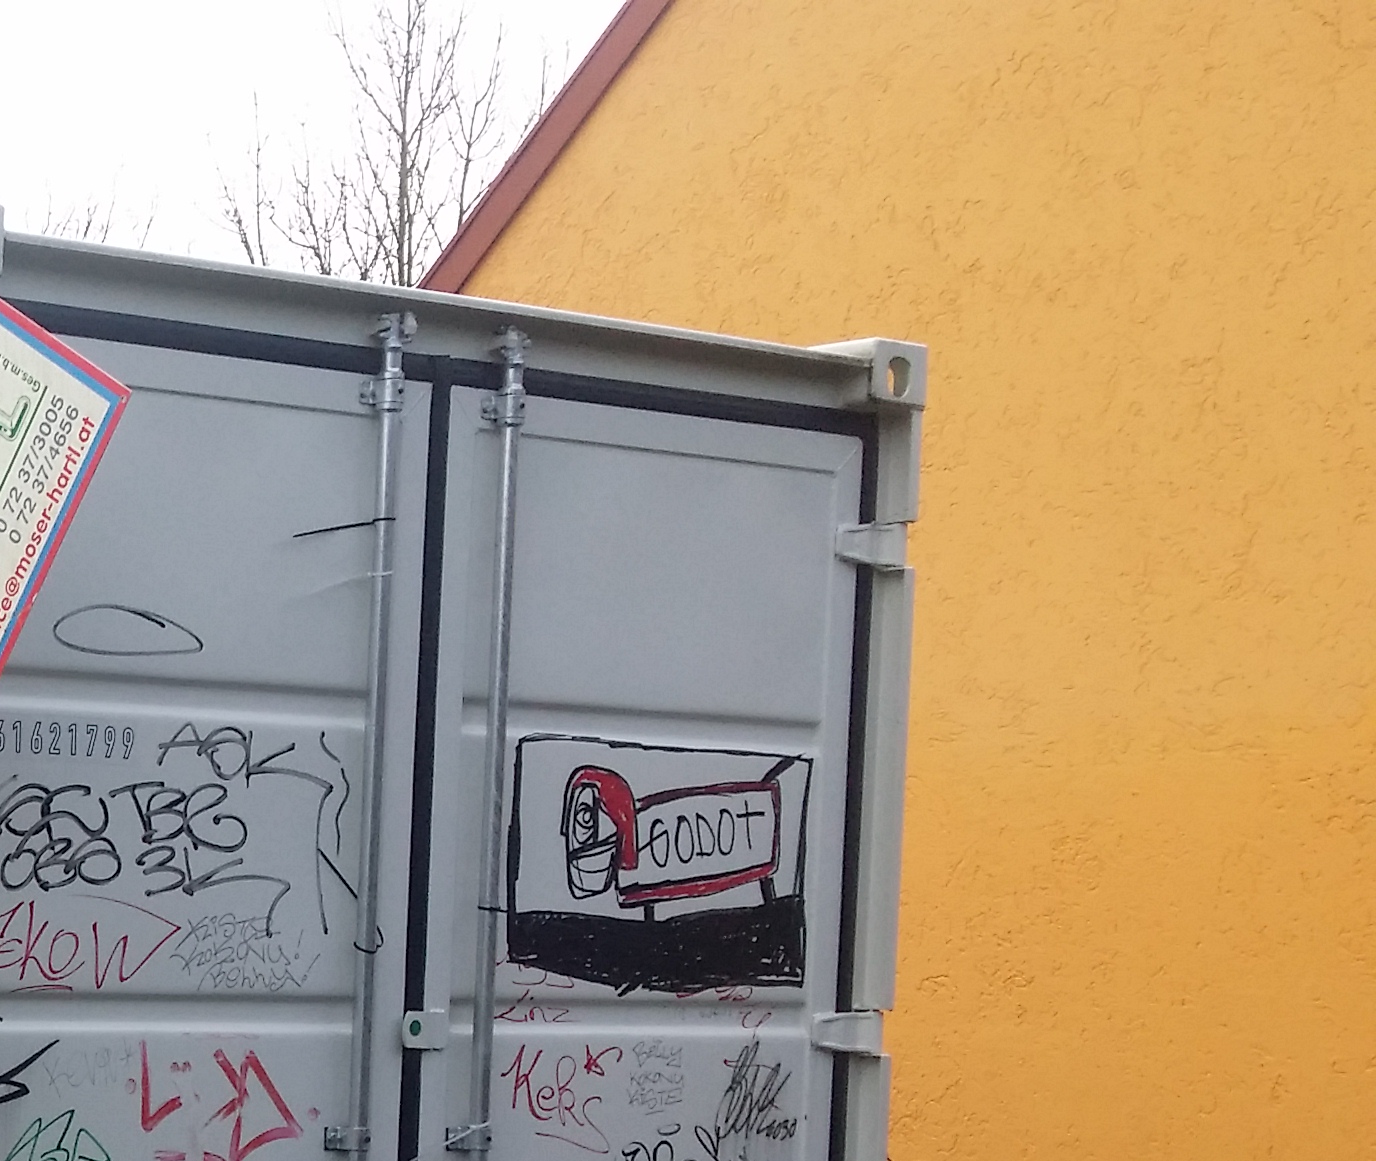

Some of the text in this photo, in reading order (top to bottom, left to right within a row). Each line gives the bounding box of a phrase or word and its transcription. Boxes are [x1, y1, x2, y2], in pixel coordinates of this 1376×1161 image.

[3, 484, 23, 517] 72
[17, 394, 66, 480] 37/3005
[9, 530, 23, 546] 0
[16, 496, 38, 528] 72
[31, 404, 81, 490] 37/4656
[639, 800, 765, 868] GODOT
